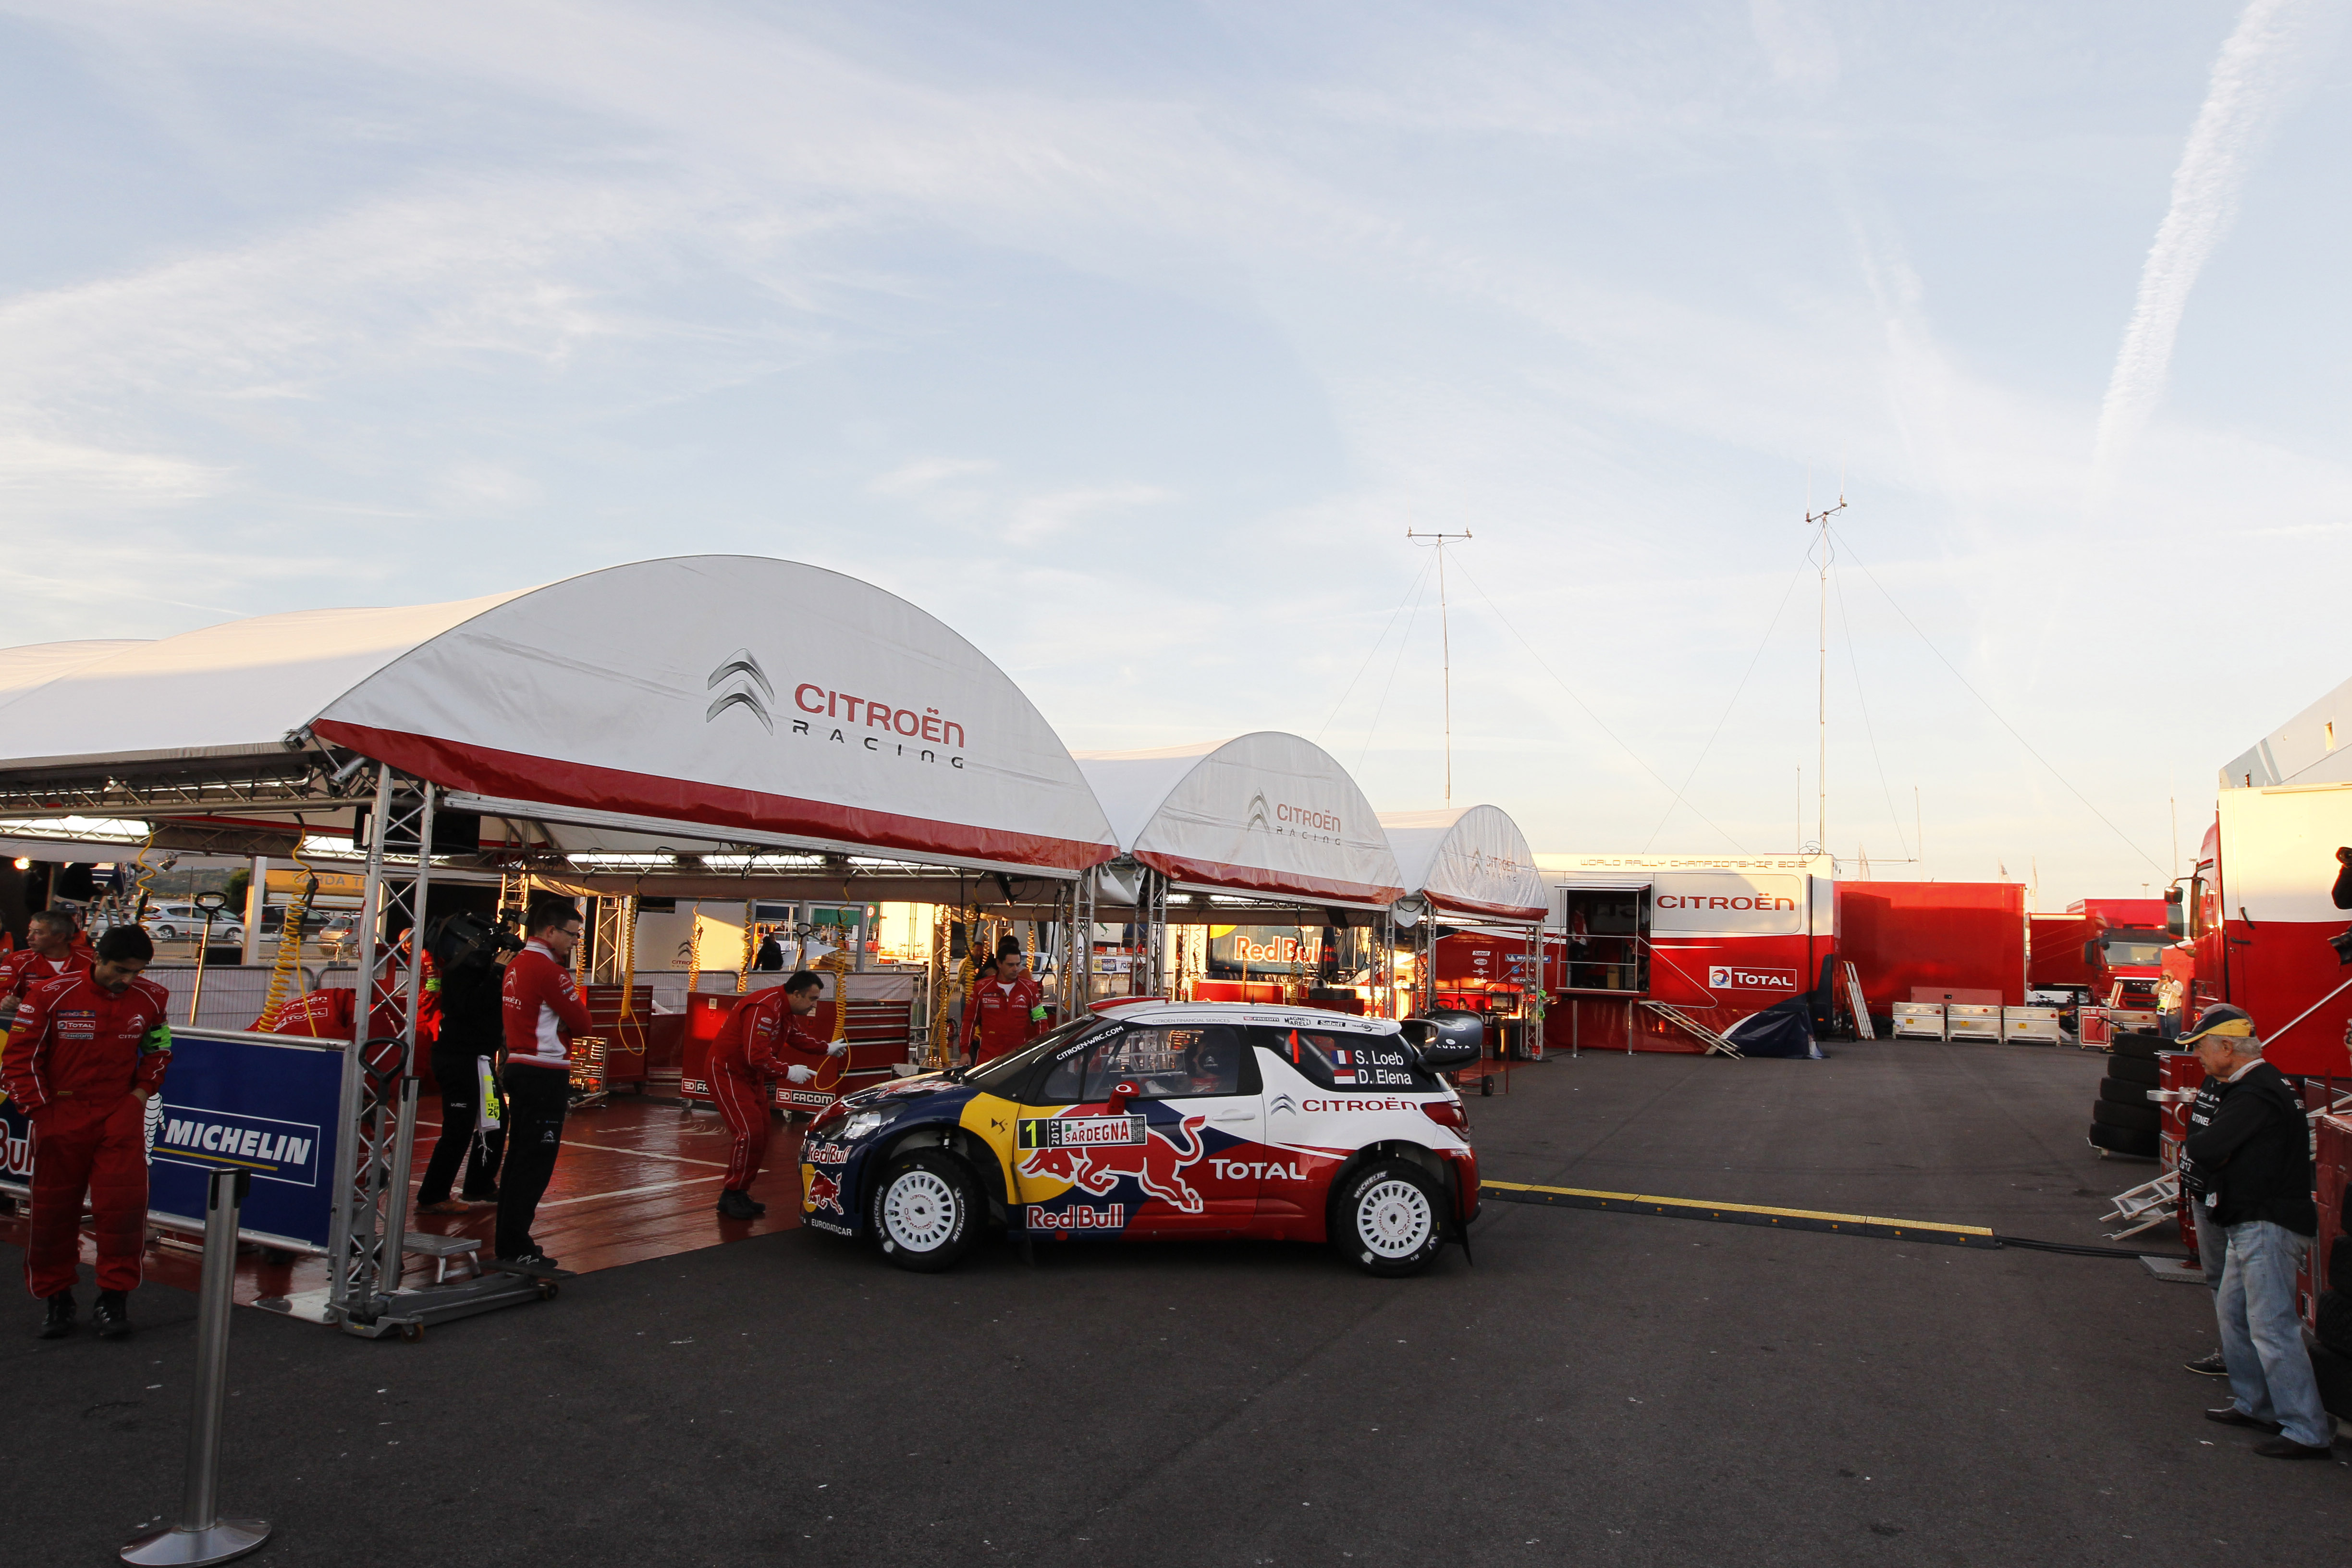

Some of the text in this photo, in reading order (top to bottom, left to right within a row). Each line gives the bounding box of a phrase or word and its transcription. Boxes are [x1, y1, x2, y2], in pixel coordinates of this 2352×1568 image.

[795, 683, 964, 748] CITROËN
[793, 720, 964, 769] RACING
[1277, 803, 1341, 833] CITROËN
[1276, 826, 1341, 845] RACING
[1656, 893, 1795, 911] CITROËN
[1281, 937, 1323, 964] Bul
[1734, 972, 1793, 987] TOTAL
[1056, 1026, 1124, 1060] CITROEN-WRC.COM
[1355, 1050, 1404, 1065] S. Loeb
[1358, 1069, 1412, 1085] D. Elena
[793, 1094, 833, 1104] FACOM
[1302, 1097, 1418, 1112] CITROËN
[164, 1118, 311, 1165] MICHELIN
[1026, 1120, 1037, 1147] 1
[1051, 1121, 1059, 1145] 2012
[1065, 1121, 1129, 1142] SARDEGNA
[807, 1142, 853, 1164] Red Bull
[1209, 1159, 1307, 1180] TOTAL
[1354, 1171, 1387, 1199] MICHELIN
[874, 1185, 884, 1227] MICHELIN
[1027, 1203, 1124, 1229] Red Bull
[811, 1218, 852, 1236] EURODATACAR
